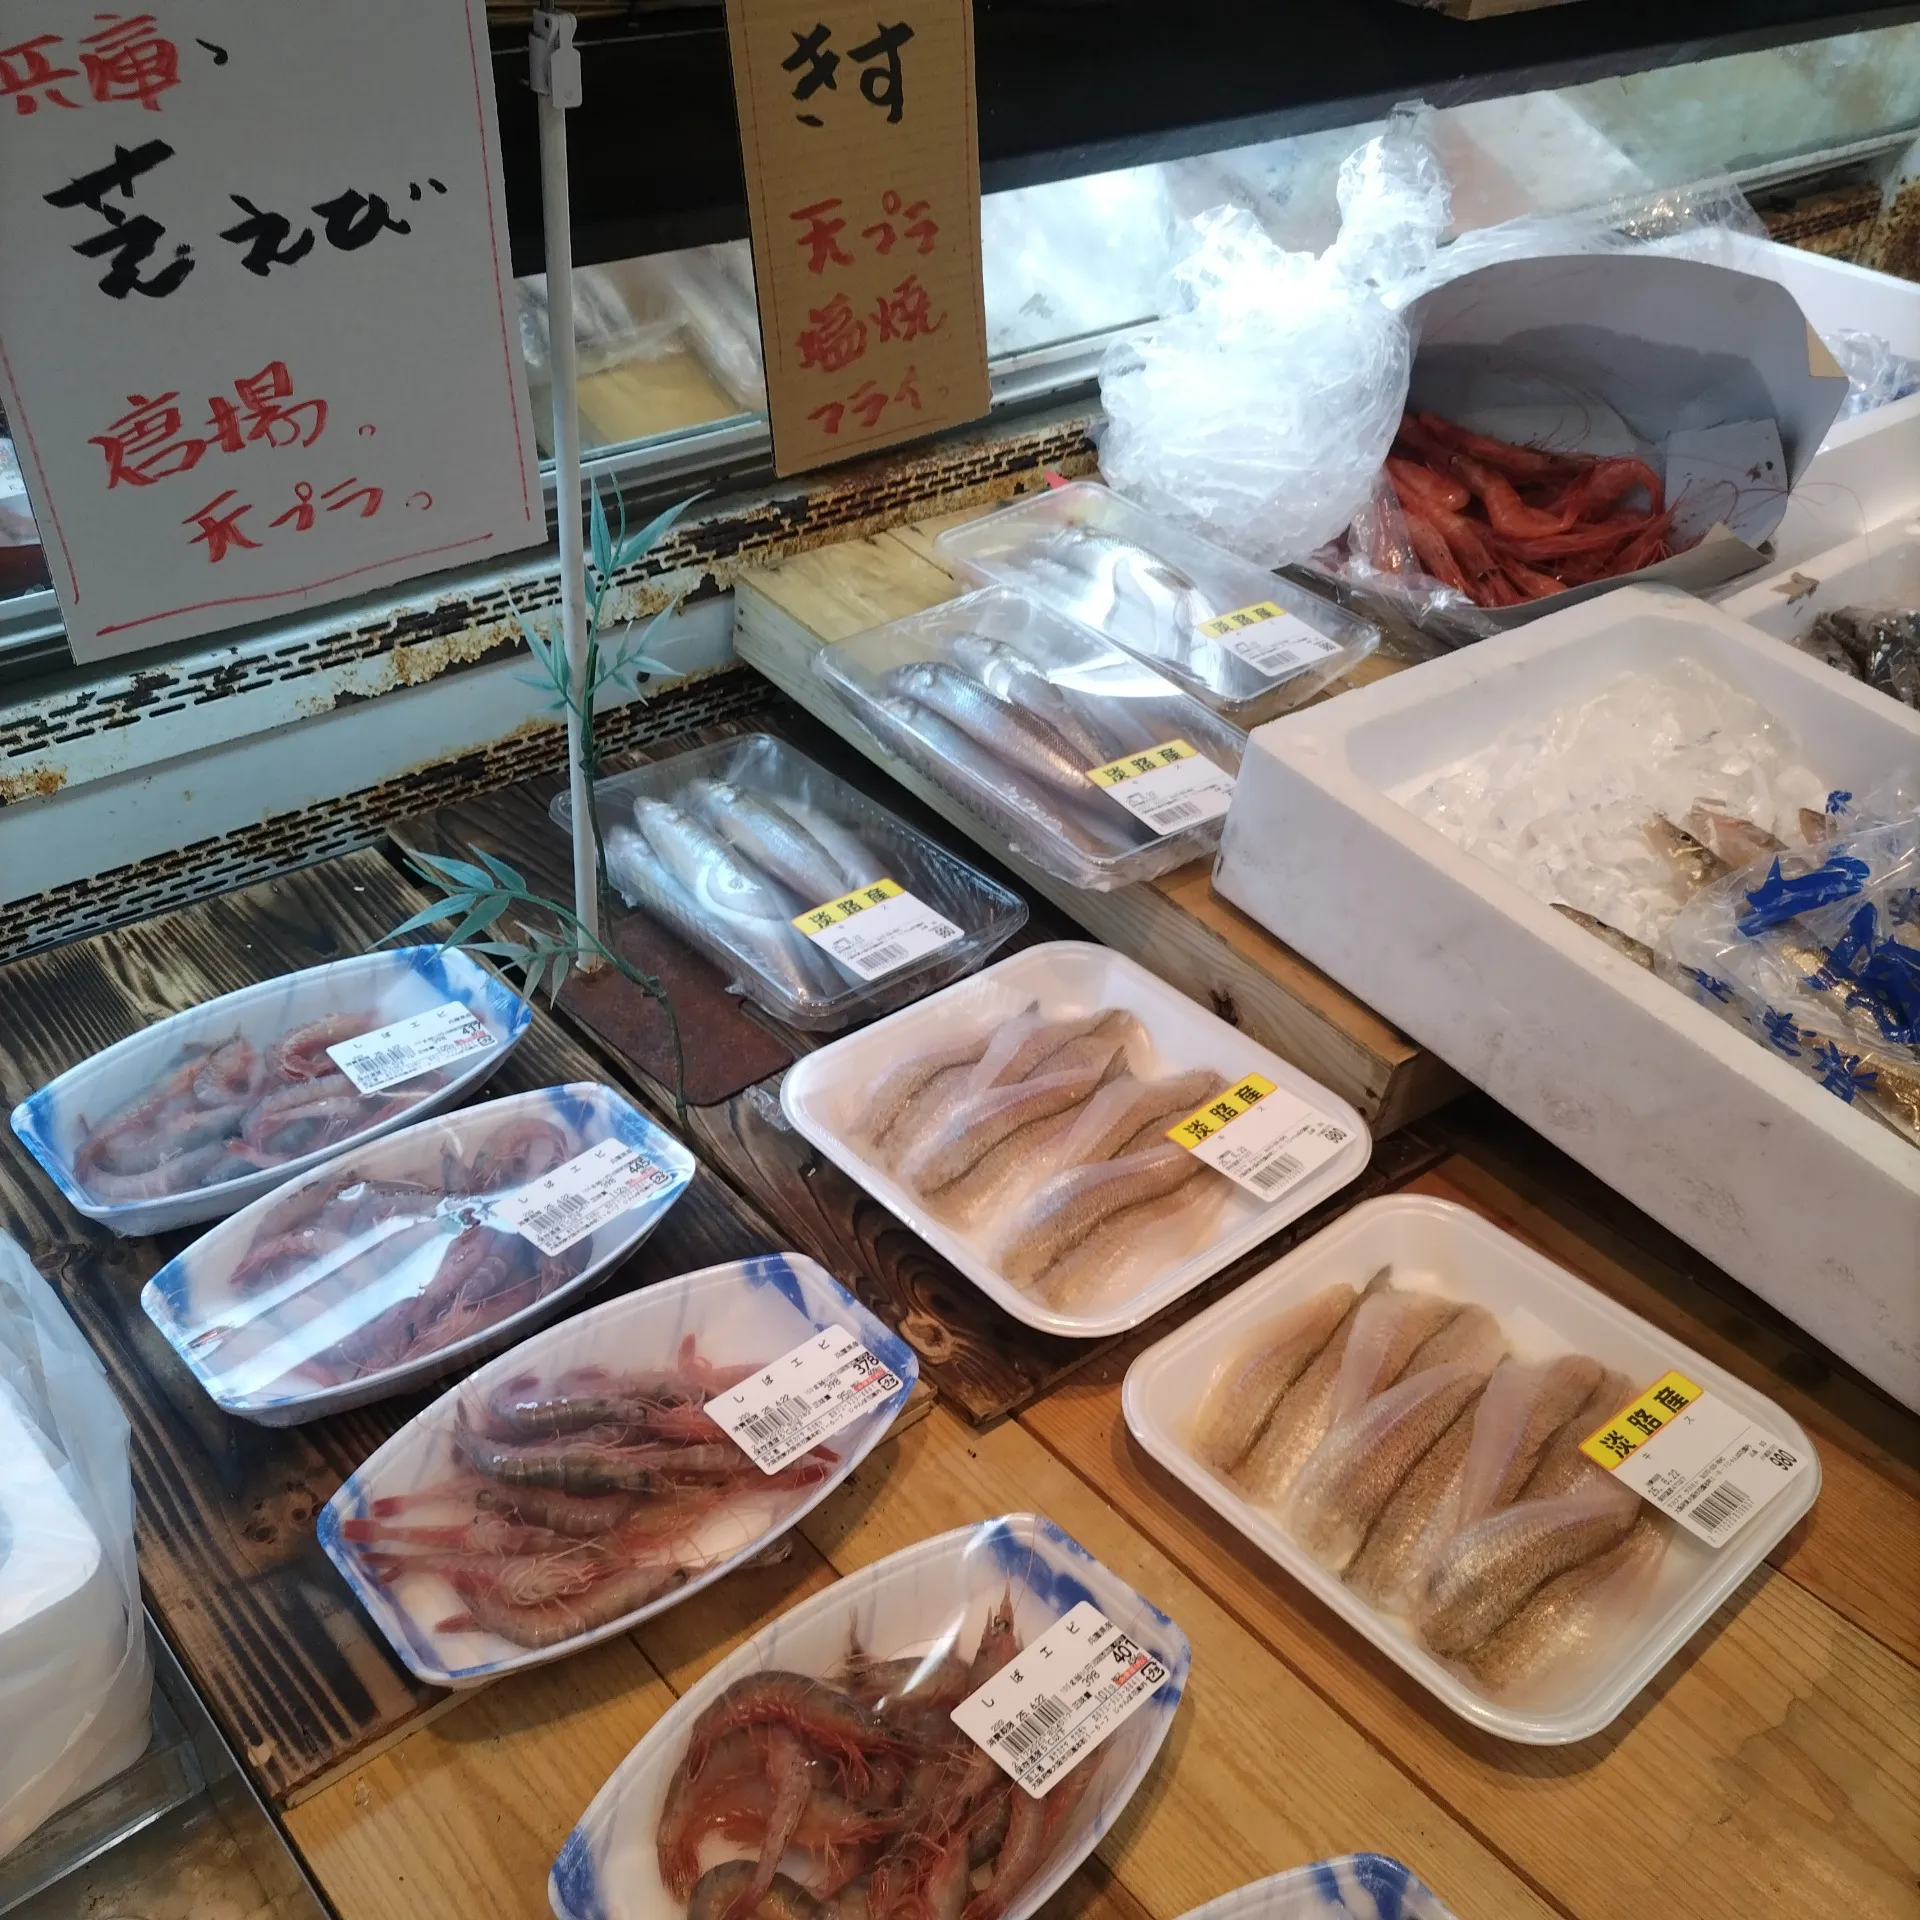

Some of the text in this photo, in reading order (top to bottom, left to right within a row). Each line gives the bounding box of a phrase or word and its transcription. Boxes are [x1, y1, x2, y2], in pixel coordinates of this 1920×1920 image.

[781, 23, 914, 126] きす
[790, 190, 939, 274] 天プラ
[796, 275, 947, 372] 塩焼
[1103, 747, 1183, 783] 淡路産
[809, 887, 890, 929] 淡路産
[1183, 1084, 1263, 1140] 淡路産
[732, 1339, 830, 1404] しばエビ
[852, 1354, 880, 1375] 378
[1599, 1386, 1689, 1458] 淡路産
[1641, 1414, 1695, 1460] キス
[1768, 1448, 1797, 1471] 980
[1085, 1620, 1115, 1646] 兵庫県産
[1111, 1638, 1139, 1664] 401
[980, 1620, 1080, 1708] しばエビ
[1080, 1669, 1100, 1687] 398
[1071, 1690, 1093, 1711] 正味量
[1093, 1683, 1117, 1704] 101g
[988, 1720, 1015, 1745] 消費期限
